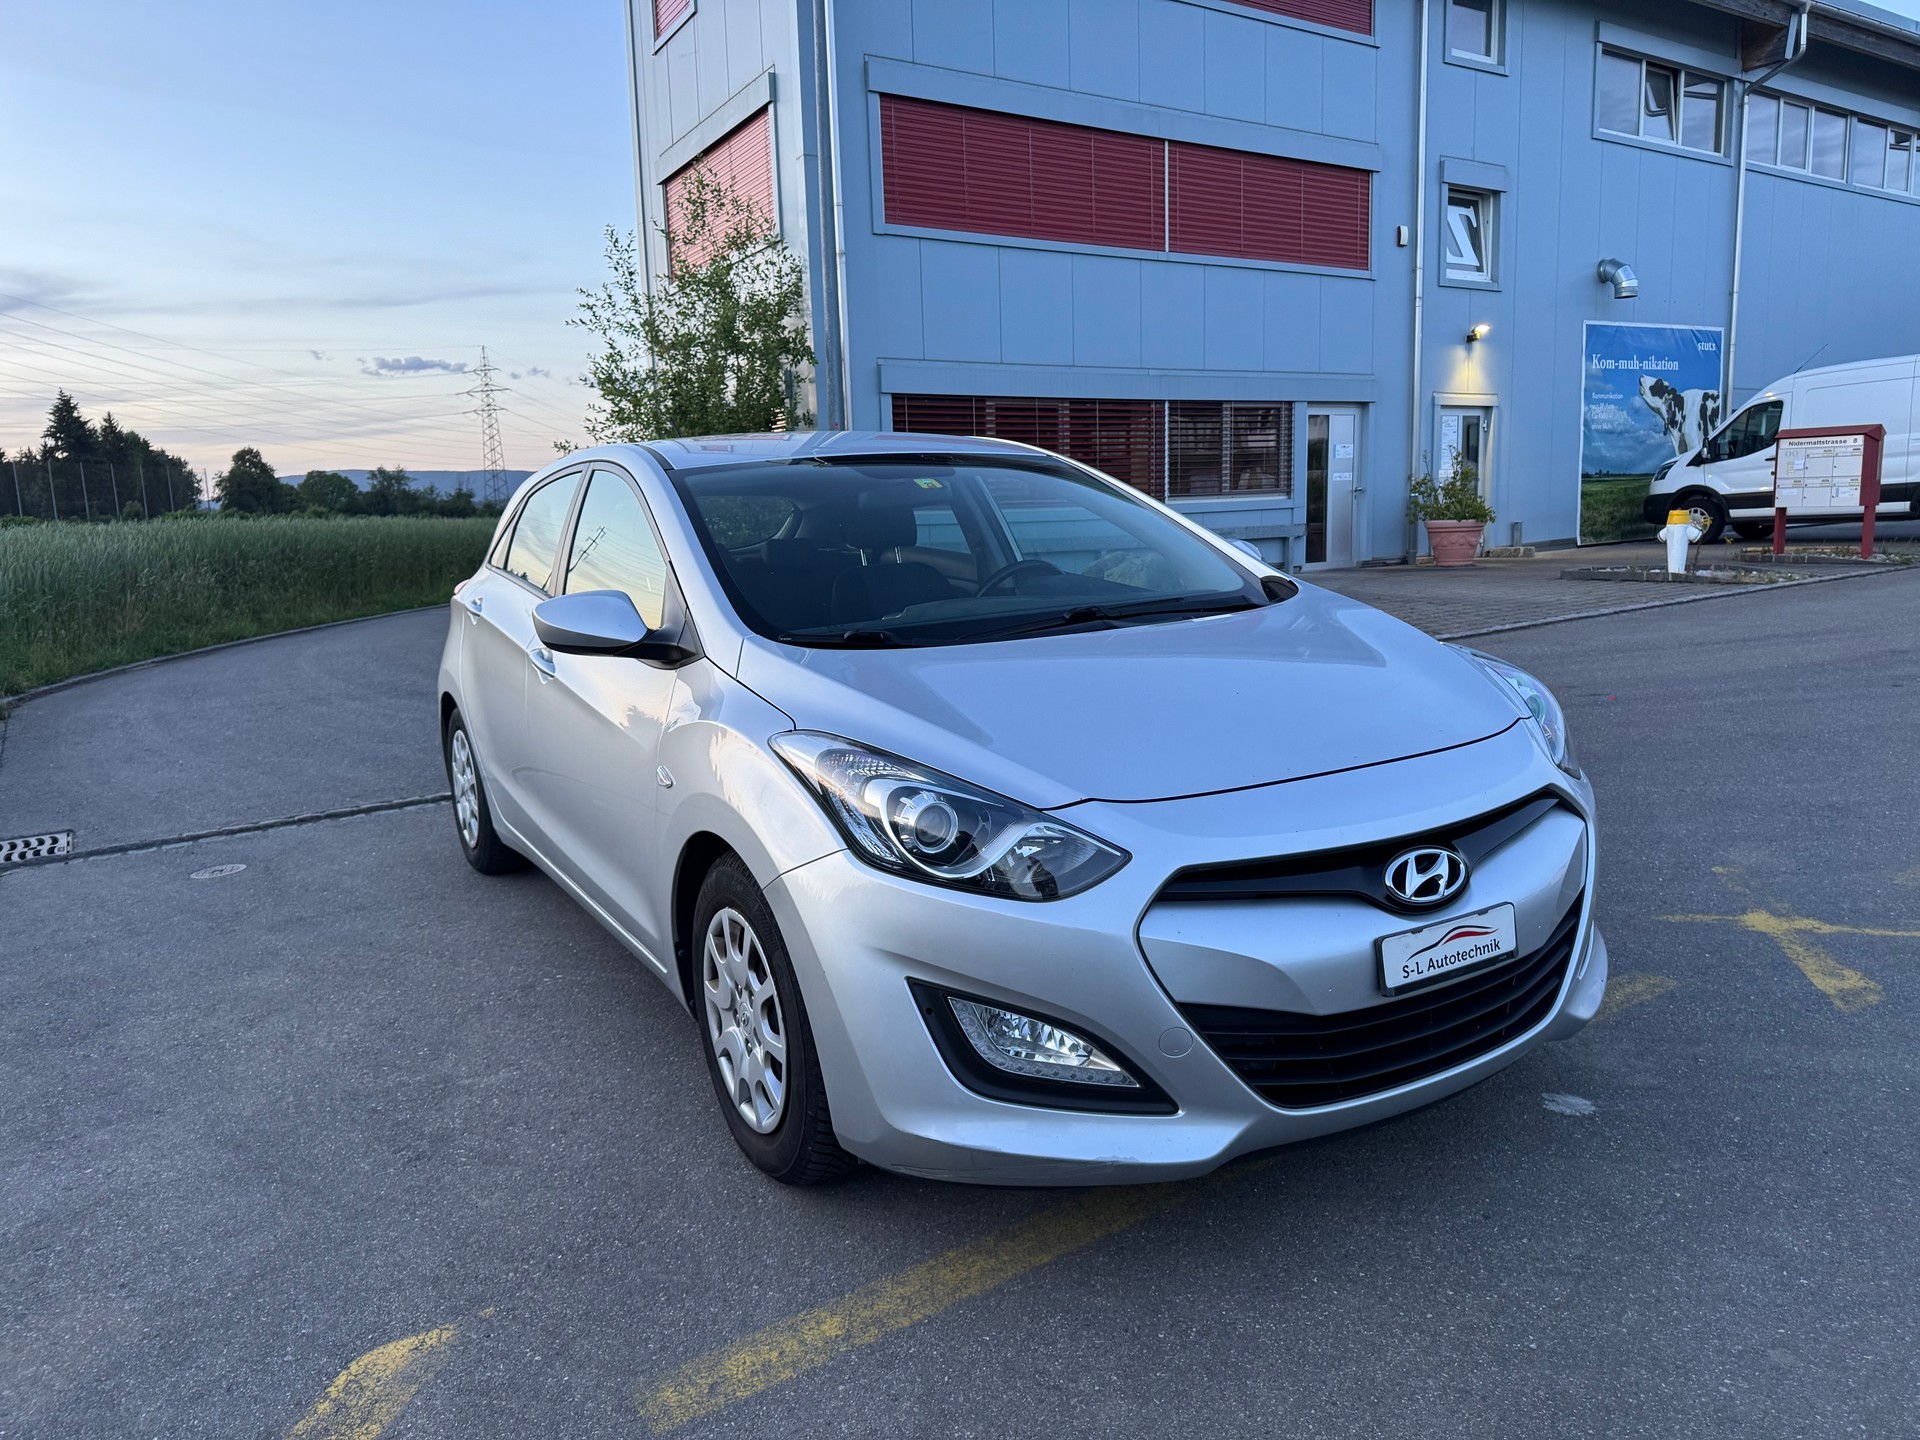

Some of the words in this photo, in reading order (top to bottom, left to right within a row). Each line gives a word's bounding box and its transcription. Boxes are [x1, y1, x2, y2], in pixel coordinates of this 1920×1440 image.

[1592, 353, 1679, 371] Kom-muh-nikation
[1788, 439, 1847, 447] Nidermattstrasse
[1402, 962, 1424, 979] S-L
[1427, 938, 1501, 972] Autotechnik
